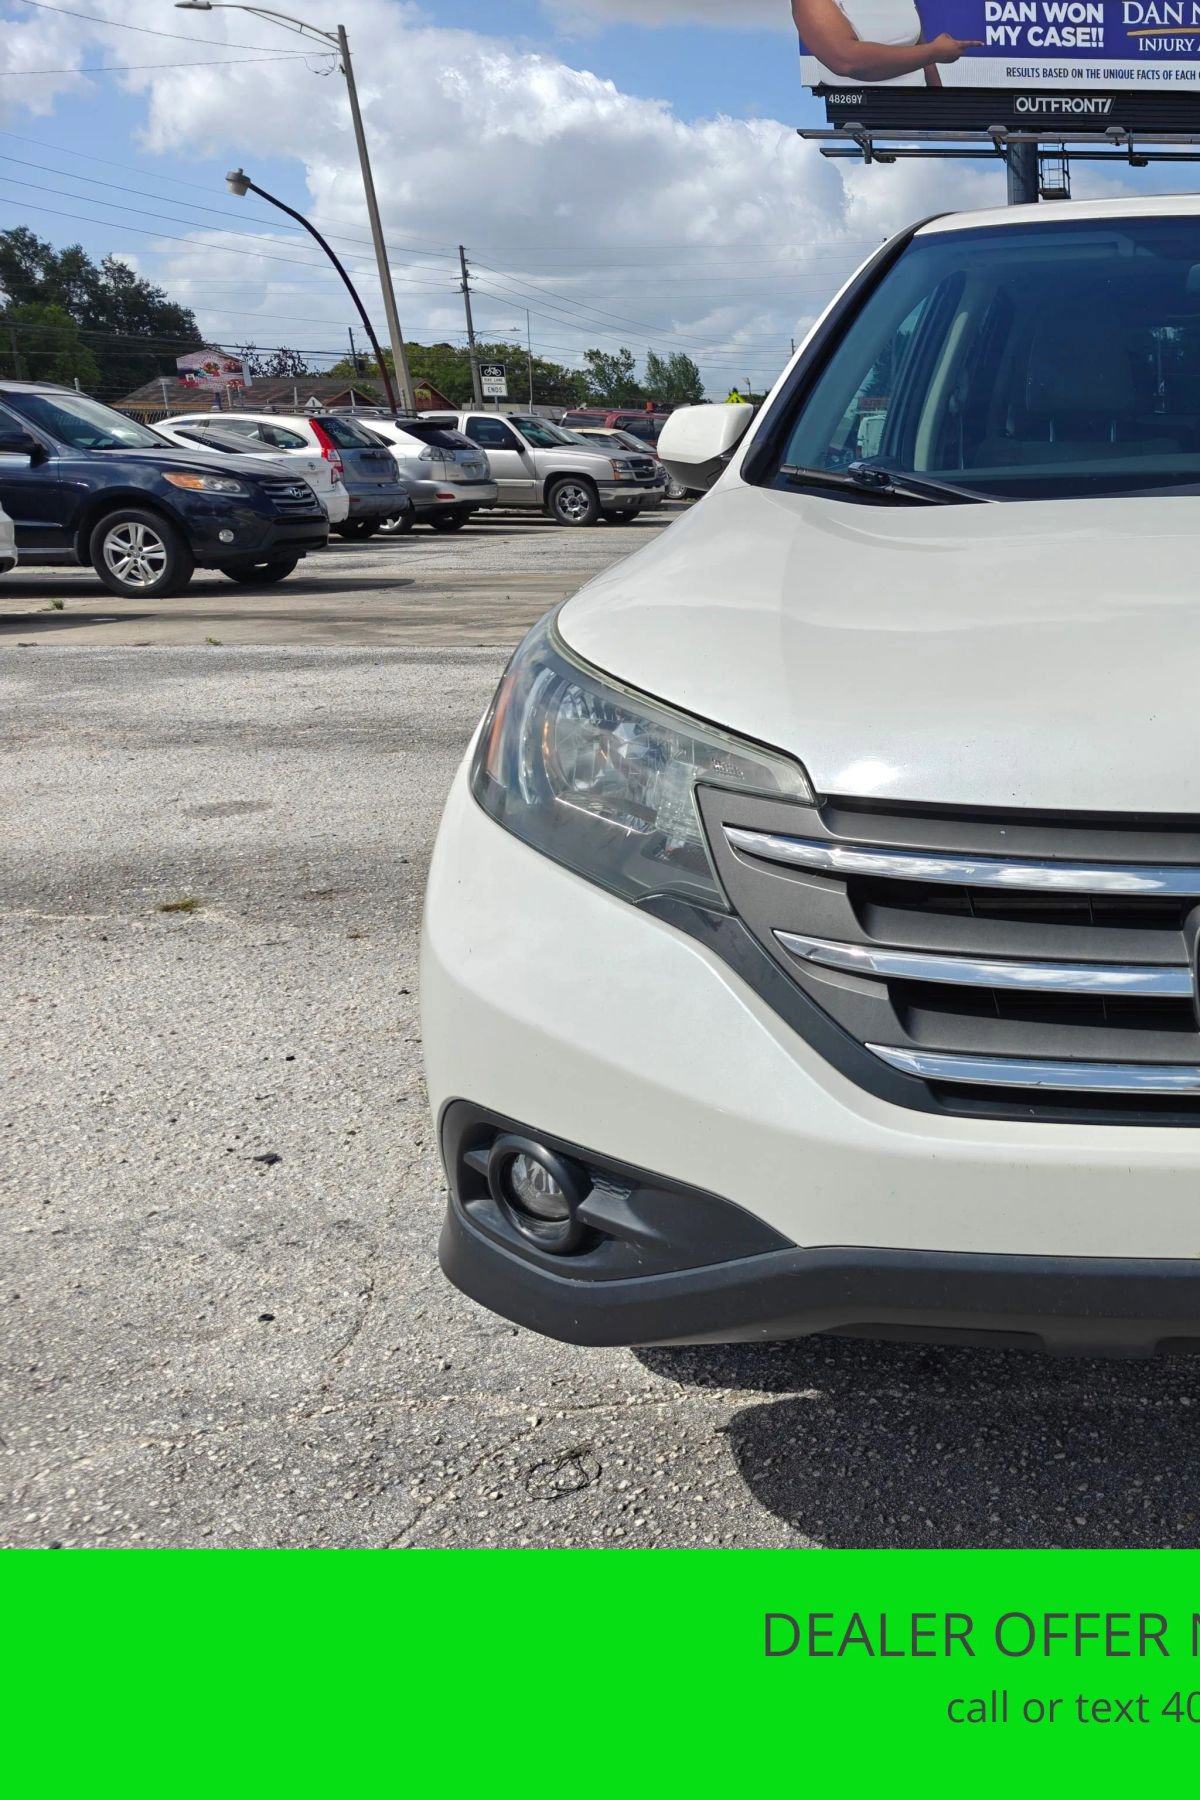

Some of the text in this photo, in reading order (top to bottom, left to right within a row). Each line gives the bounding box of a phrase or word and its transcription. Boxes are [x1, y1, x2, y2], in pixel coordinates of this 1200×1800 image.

[984, 1, 1104, 24] DAN WON
[1122, 1, 1184, 25] DAN
[985, 26, 1104, 48] MY CASE!!
[1138, 38, 1195, 52] INJURY
[1006, 67, 1040, 78] RESULTS
[1042, 68, 1069, 79] BASED
[1071, 68, 1083, 79] ON
[1086, 69, 1101, 79] THE
[1103, 69, 1135, 80] UNIQUE
[1137, 70, 1160, 80] FACTS
[1163, 70, 1173, 80] OF
[1175, 70, 1196, 80] EACH
[829, 94, 863, 104] 48269Y
